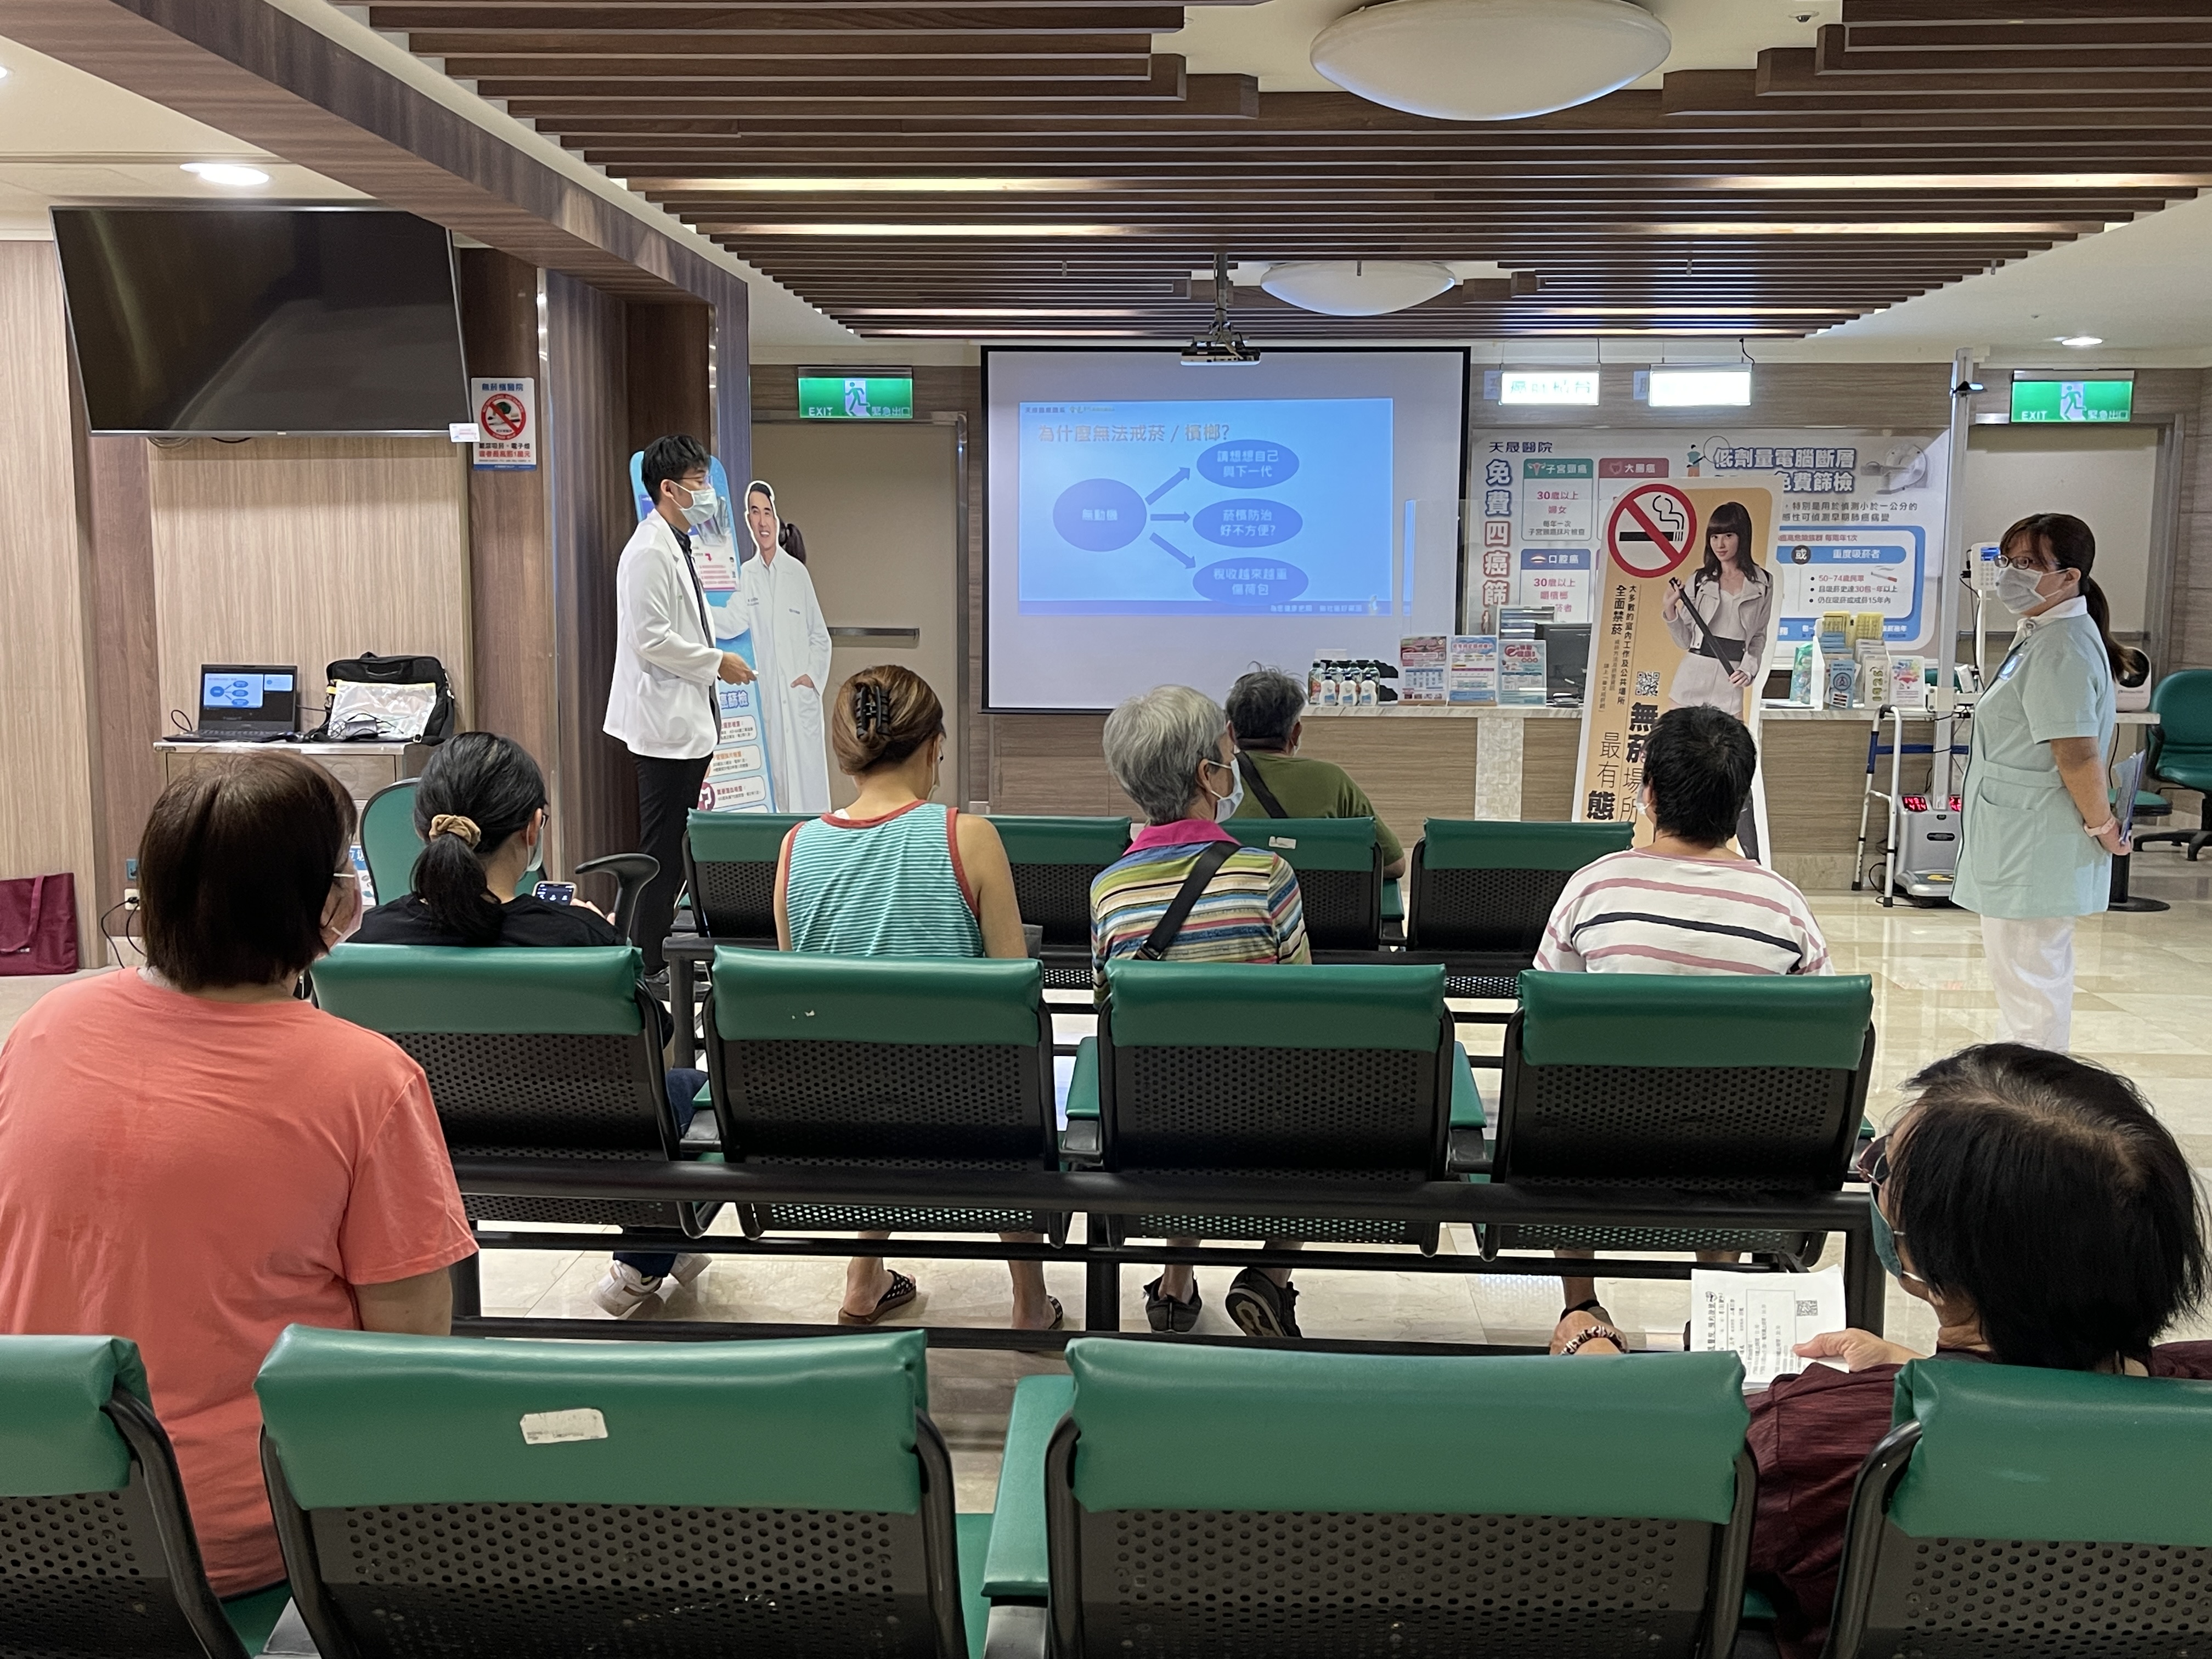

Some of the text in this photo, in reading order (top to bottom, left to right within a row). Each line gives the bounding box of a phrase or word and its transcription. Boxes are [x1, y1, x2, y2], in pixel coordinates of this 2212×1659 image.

[809, 407, 833, 416] EXIT
[871, 406, 910, 416] 緊急出口
[2021, 410, 2047, 420] EXIT
[2087, 410, 2129, 420] 緊急出口
[1038, 425, 1165, 442] 為什麼無法戒菸
[1217, 450, 1279, 462] 請想想自己
[1713, 447, 1857, 469] 低劑量電腦斷層
[1223, 465, 1273, 478] 與下一代
[1545, 464, 1588, 475] 子宮頸癌
[1624, 464, 1656, 474] 大腸癌
[1536, 490, 1579, 500] 30歲以上
[1082, 509, 1118, 521] 無動機
[1223, 509, 1272, 521] 菸檳防治
[1548, 505, 1567, 514] 婦女
[1220, 524, 1276, 537] 好不方便?
[1548, 554, 1579, 564] 口腔癌
[1795, 549, 1807, 560] 或
[1832, 549, 1881, 559] 重度吸菸者
[1533, 578, 1576, 588] 30歲以上
[1611, 585, 1627, 635] 全面禁菸
[1617, 585, 1637, 705] 大多數的室內工作及公共場所
